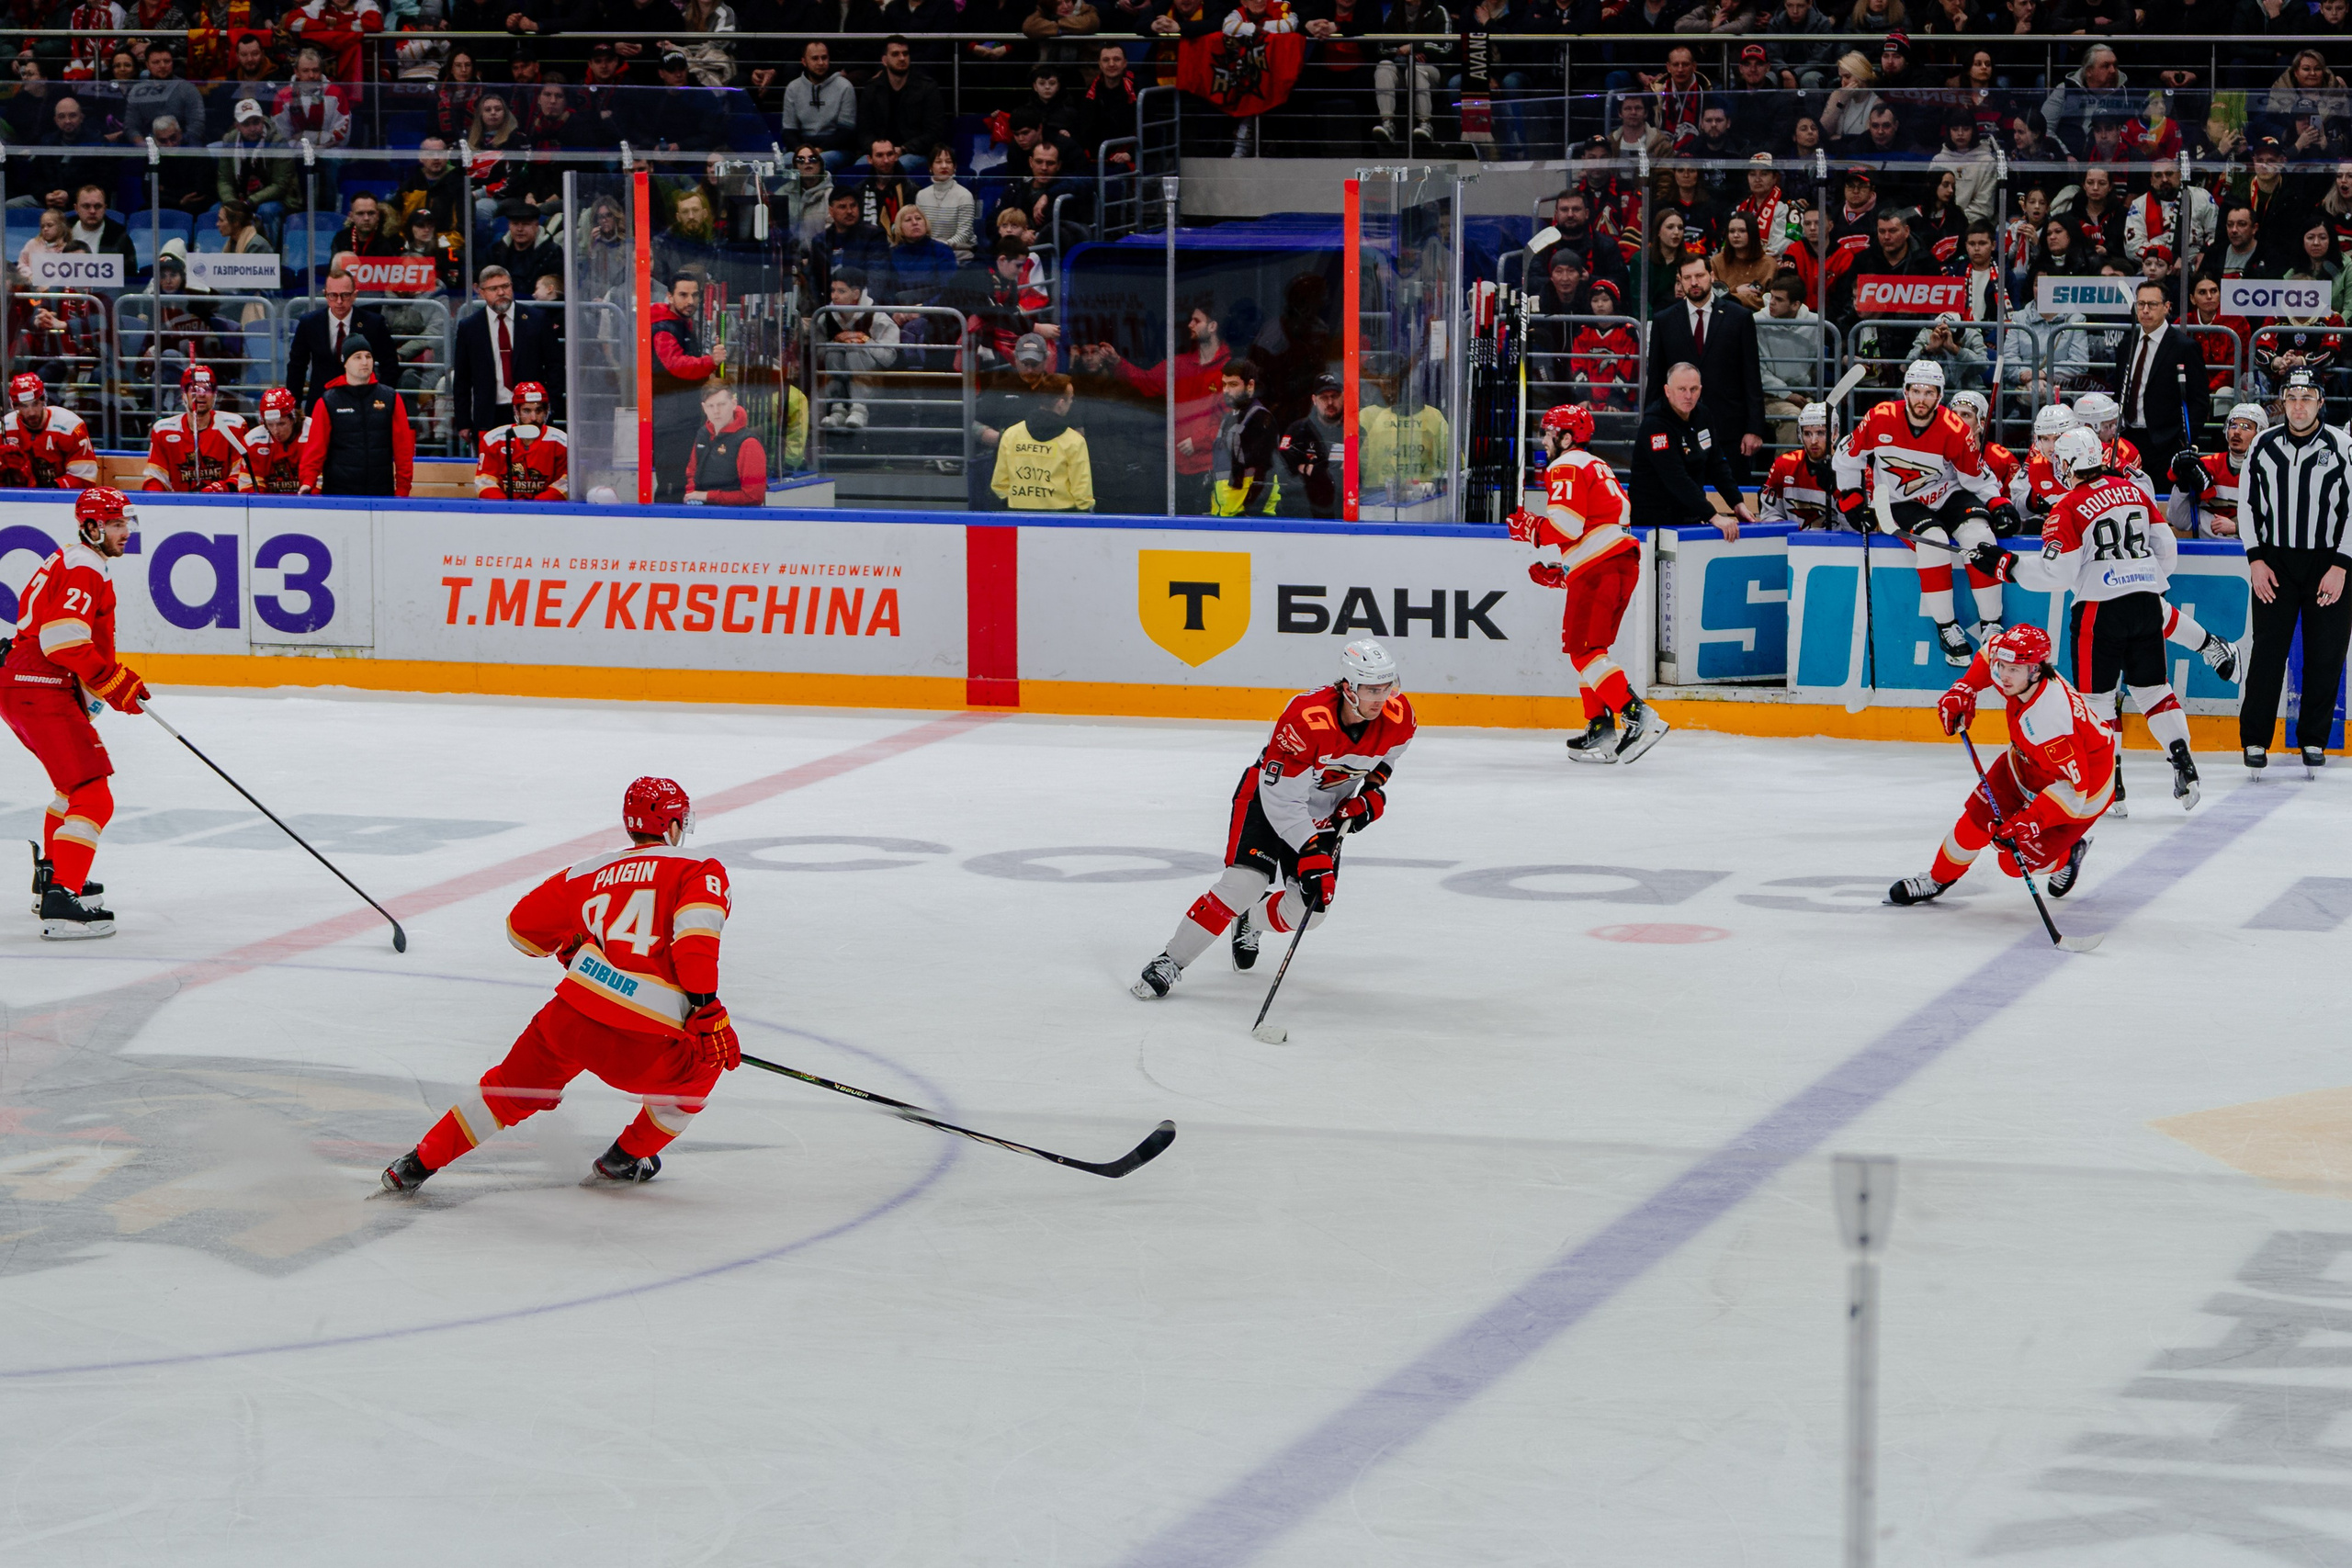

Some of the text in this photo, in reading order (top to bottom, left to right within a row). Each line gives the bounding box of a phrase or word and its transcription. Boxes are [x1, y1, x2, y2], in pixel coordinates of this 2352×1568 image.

[41, 262, 114, 278] согаз
[212, 265, 276, 276] ГАЗПРОМБАНК
[345, 264, 434, 284] FONBET
[1860, 283, 1962, 305] FONBET
[2233, 288, 2320, 308] согаз
[1015, 444, 1053, 454] SAFETY
[2087, 456, 2098, 466] 86
[1012, 485, 1056, 498] SAFETY
[1551, 480, 1572, 501] 21
[2076, 486, 2143, 520] BOUCHER
[2093, 511, 2153, 561] 86
[442, 555, 902, 578] МЫ ВСЕГДА НА СВЯЗИ #REDSTARHOCKEY #UNITEDWEWIN
[63, 587, 92, 615] 27
[441, 576, 900, 637] T.ME/KRSCHINA
[1278, 585, 1509, 640] БАНК
[1373, 649, 1383, 660] 9
[14, 673, 63, 685] WARRIOR
[1264, 760, 1283, 787] 9
[593, 861, 659, 892] PAIGIN
[582, 888, 661, 957] 84
[579, 956, 639, 998] SIBUR
[838, 1084, 870, 1100] BAUER
